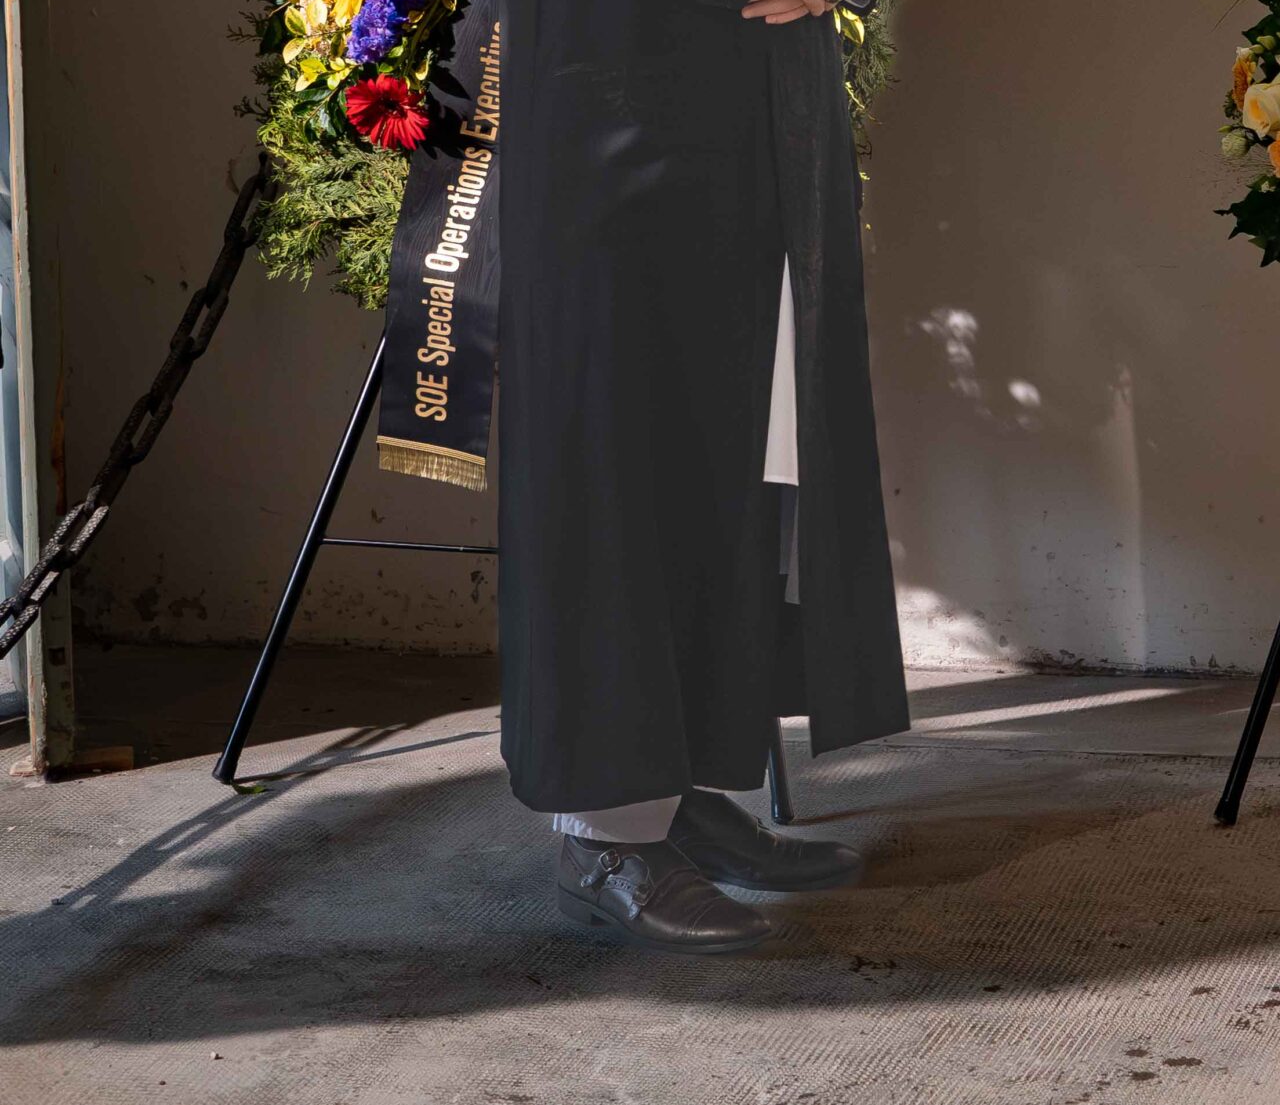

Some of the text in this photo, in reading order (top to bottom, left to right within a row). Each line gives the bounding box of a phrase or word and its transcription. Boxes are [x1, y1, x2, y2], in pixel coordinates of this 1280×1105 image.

[415, 146, 493, 423] SOE Special Operations
